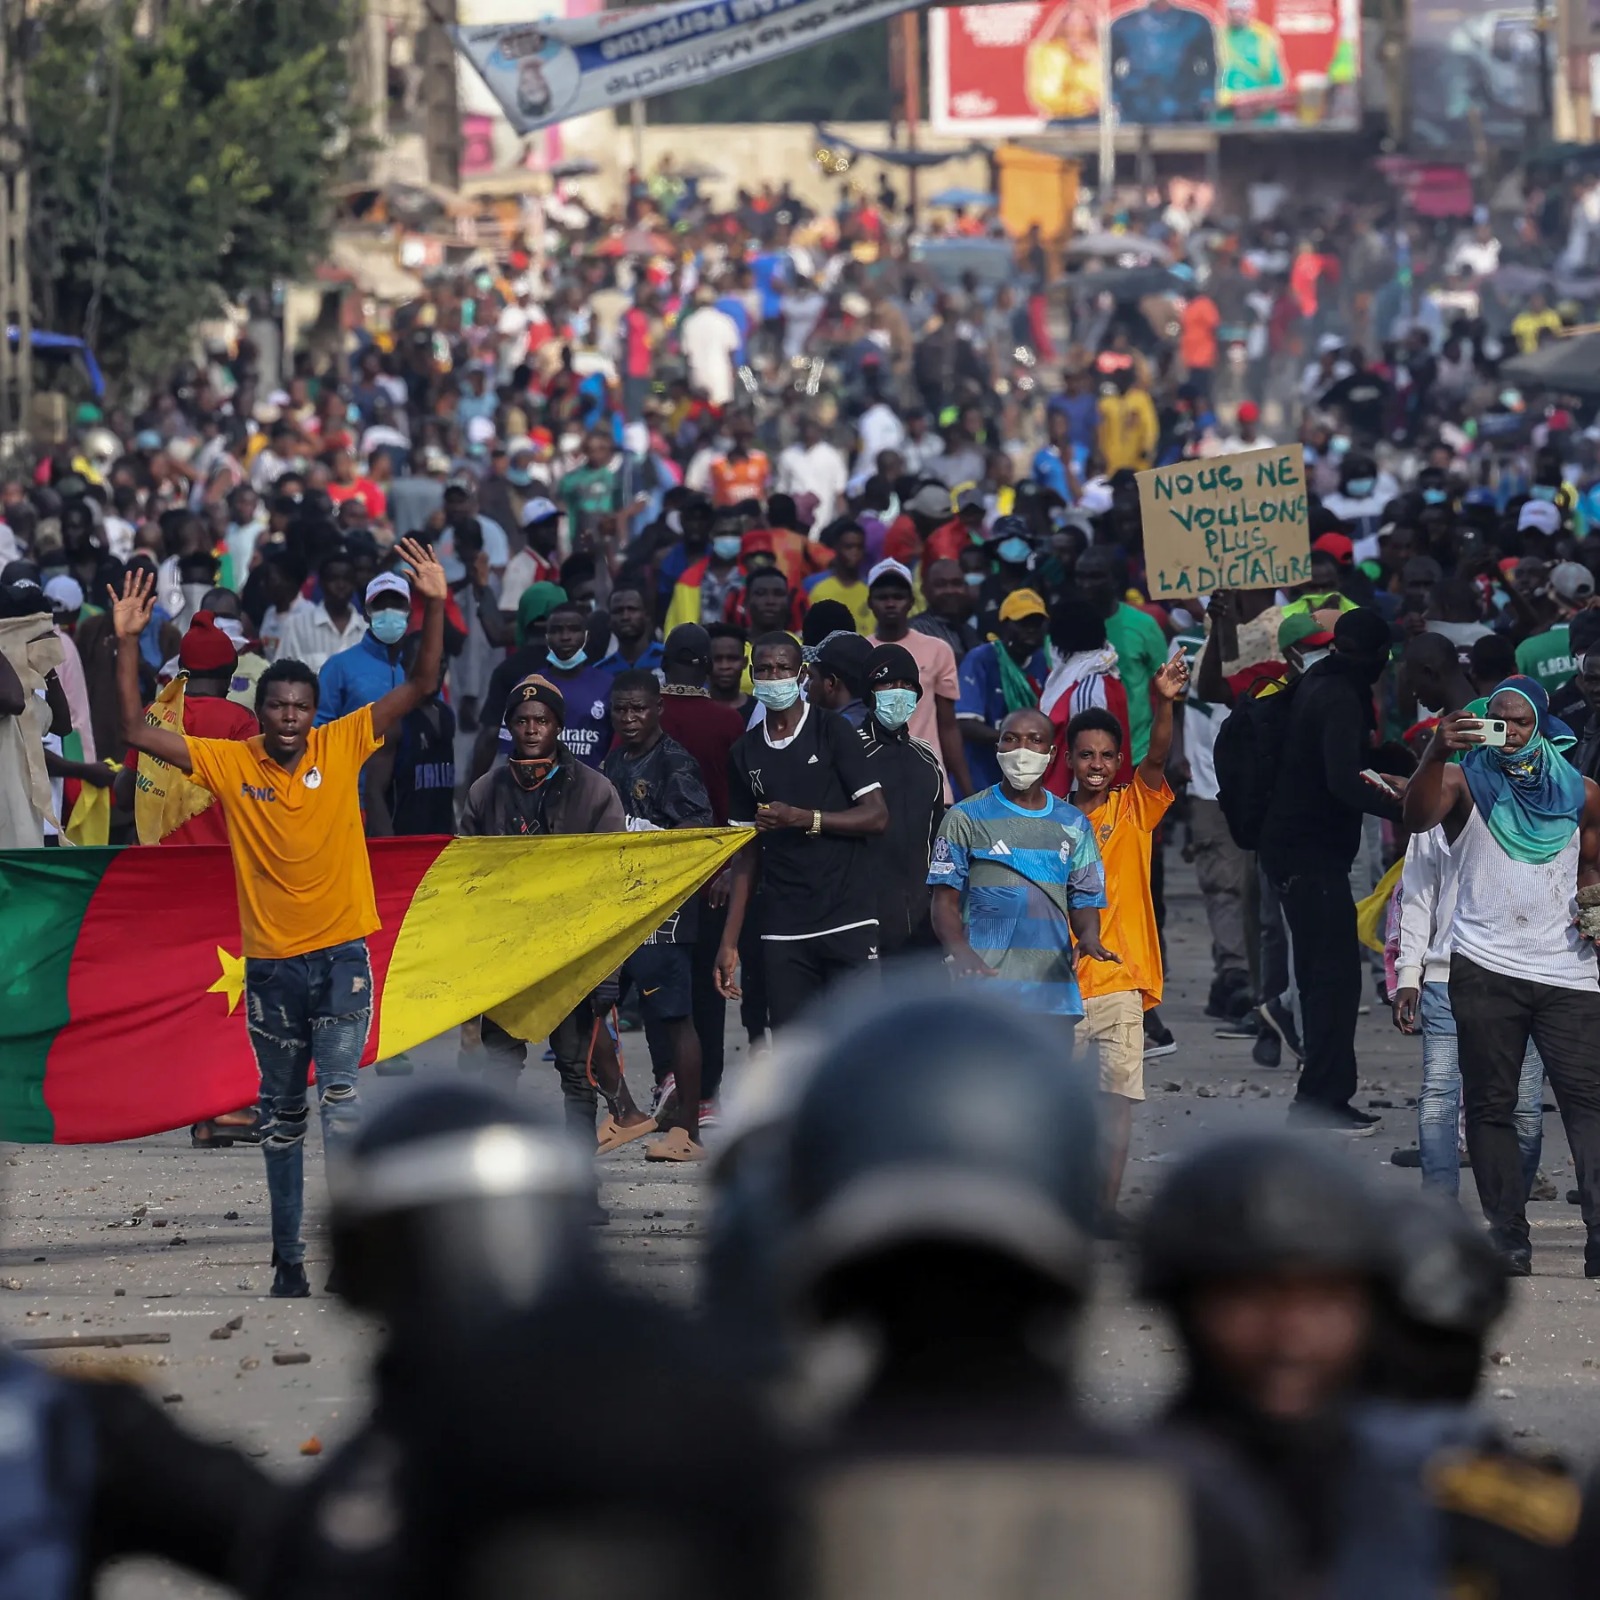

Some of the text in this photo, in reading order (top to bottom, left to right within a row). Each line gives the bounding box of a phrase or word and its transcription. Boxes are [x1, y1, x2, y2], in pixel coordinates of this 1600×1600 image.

[1155, 456, 1299, 500] NOUS NE
[1169, 495, 1309, 532] VOULONS
[1204, 526, 1268, 560] PLUS
[1158, 546, 1312, 594] LA DICTATURE
[522, 686, 538, 702] P
